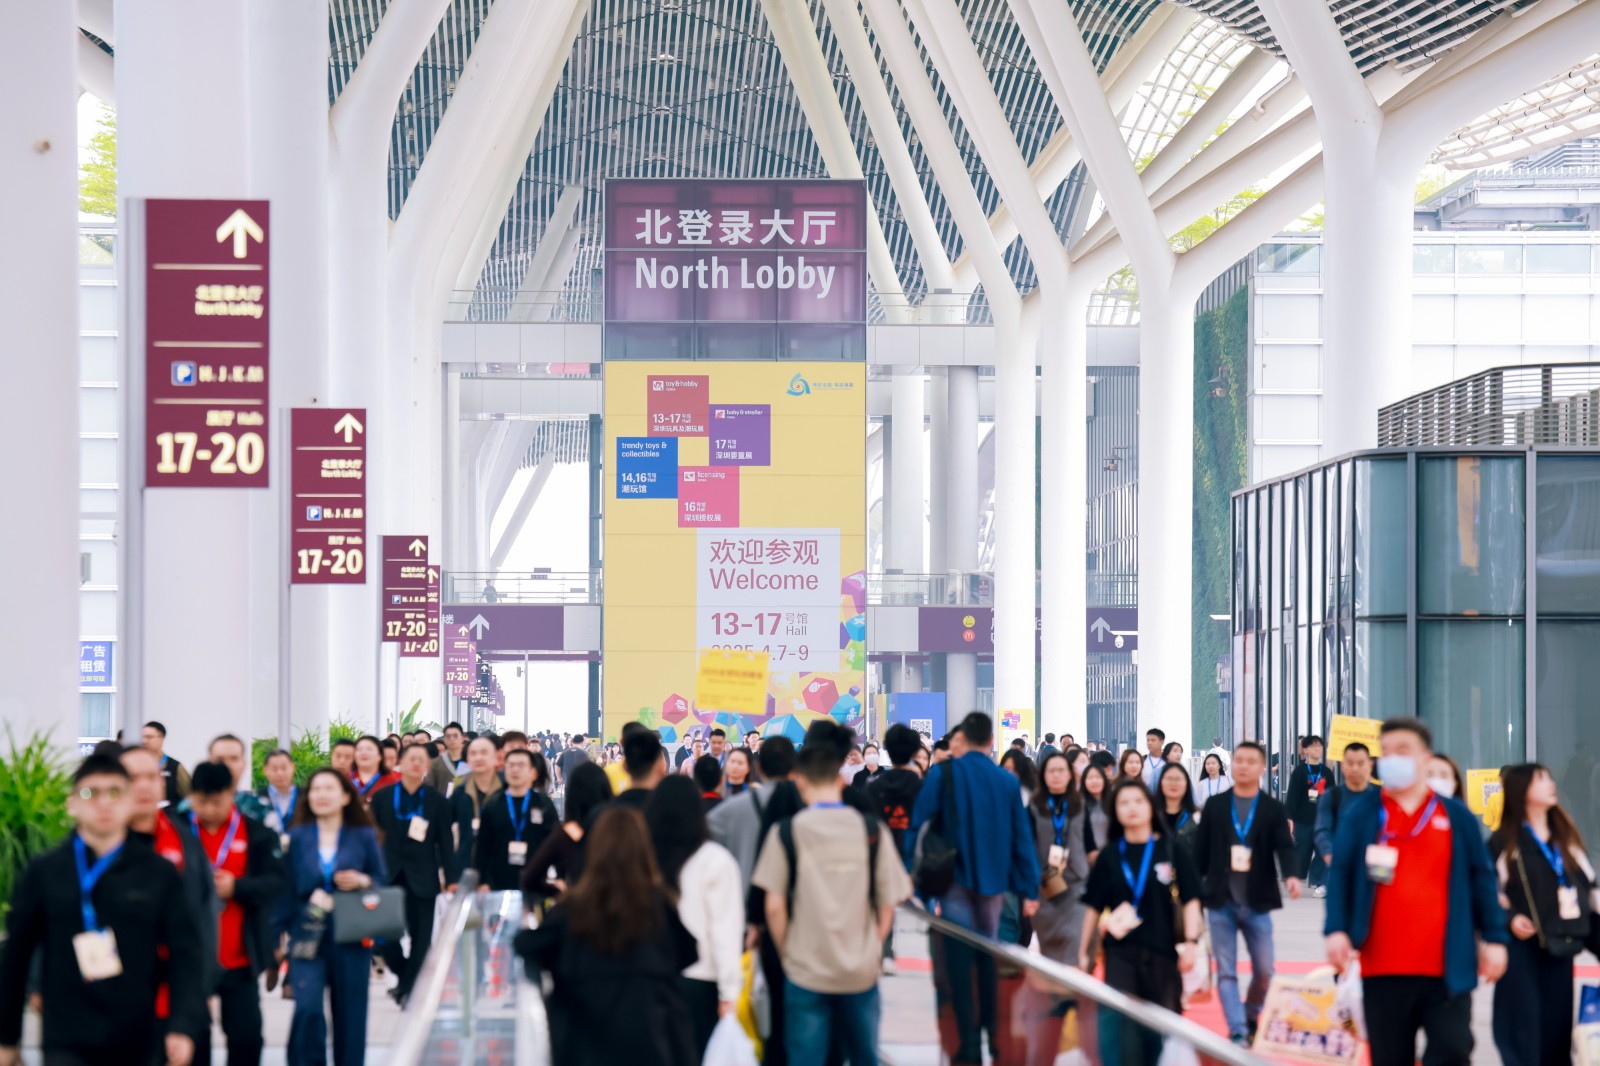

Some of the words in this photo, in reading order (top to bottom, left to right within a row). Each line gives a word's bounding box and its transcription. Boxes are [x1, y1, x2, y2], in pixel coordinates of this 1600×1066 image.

[635, 209, 836, 245] 北登录大厅
[635, 256, 729, 289] North
[741, 256, 835, 299] Lobby
[653, 413, 680, 423] 13-17
[715, 440, 726, 449] 17
[156, 432, 264, 474] 17-20
[622, 473, 646, 483] 14,16
[622, 485, 647, 493] 潮玩馆
[684, 502, 696, 511] 16
[709, 539, 819, 565] 欢迎参观
[298, 549, 363, 574] 17-20
[709, 569, 818, 590] Welcome
[386, 621, 426, 636] 17-20
[712, 613, 782, 635] 13-17
[785, 613, 808, 624] 号馆
[786, 626, 807, 636] Hall
[81, 645, 106, 657] 广告
[404, 639, 438, 652] 17-20
[80, 660, 105, 672] 租赁
[446, 672, 468, 681] 17-20
